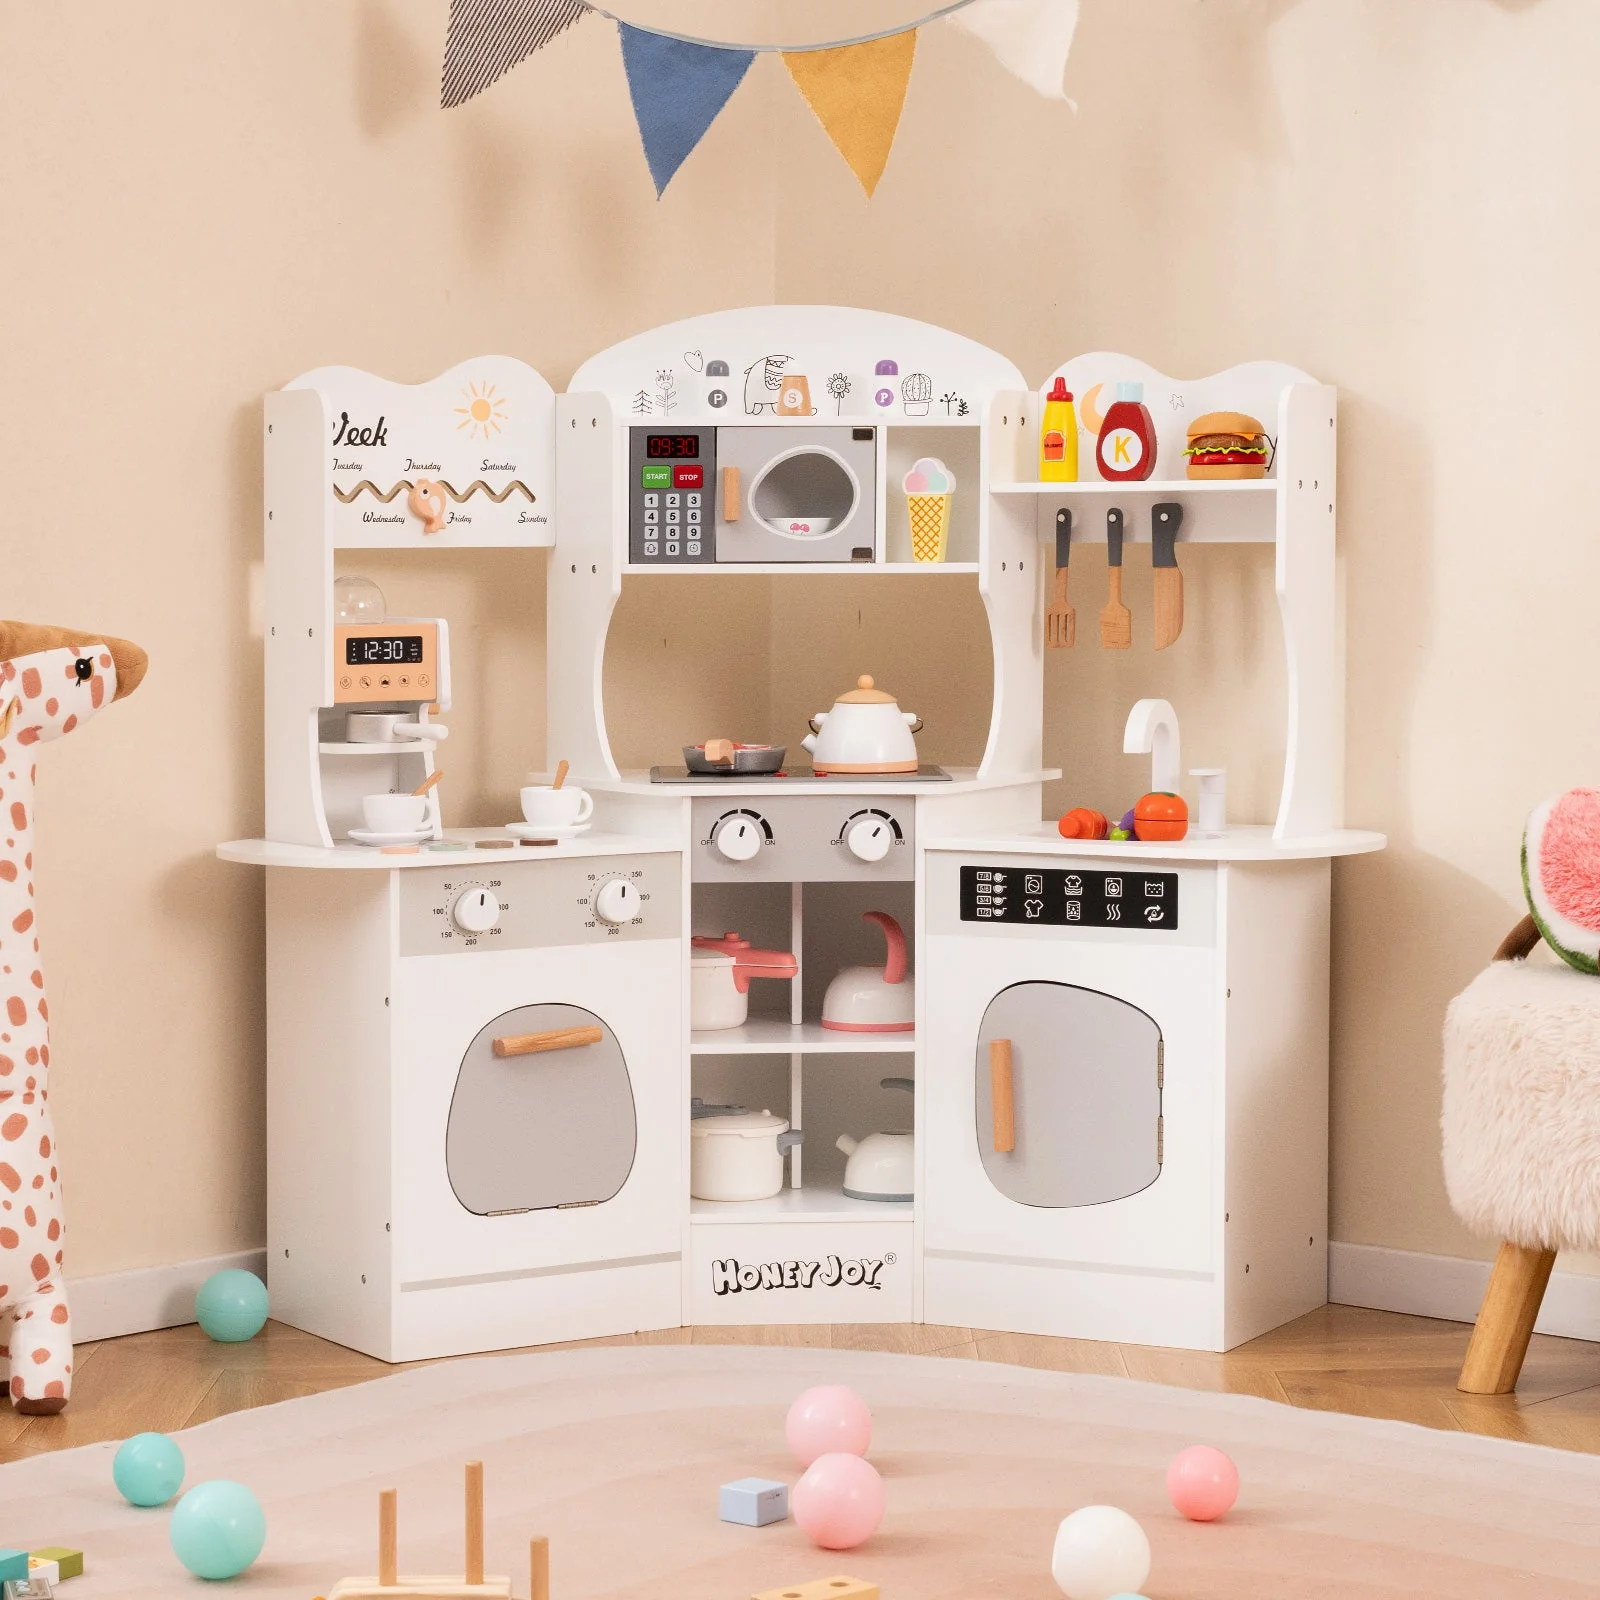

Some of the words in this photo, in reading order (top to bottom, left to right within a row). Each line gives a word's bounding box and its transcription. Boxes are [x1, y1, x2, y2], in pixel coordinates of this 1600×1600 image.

[713, 391, 723, 404] P
[788, 392, 797, 404] S
[879, 391, 889, 403] P
[650, 438, 696, 456] 09:30
[1113, 436, 1132, 463] K
[403, 459, 441, 472] Thursday
[480, 459, 517, 472] Saturday
[362, 512, 406, 524] Wednesday
[446, 512, 472, 524] Friday
[518, 512, 548, 524] Sunday
[670, 544, 676, 552] 0
[364, 640, 403, 660] 12:30
[711, 1258, 820, 1296] HONEY
[819, 1254, 884, 1290] JOY
